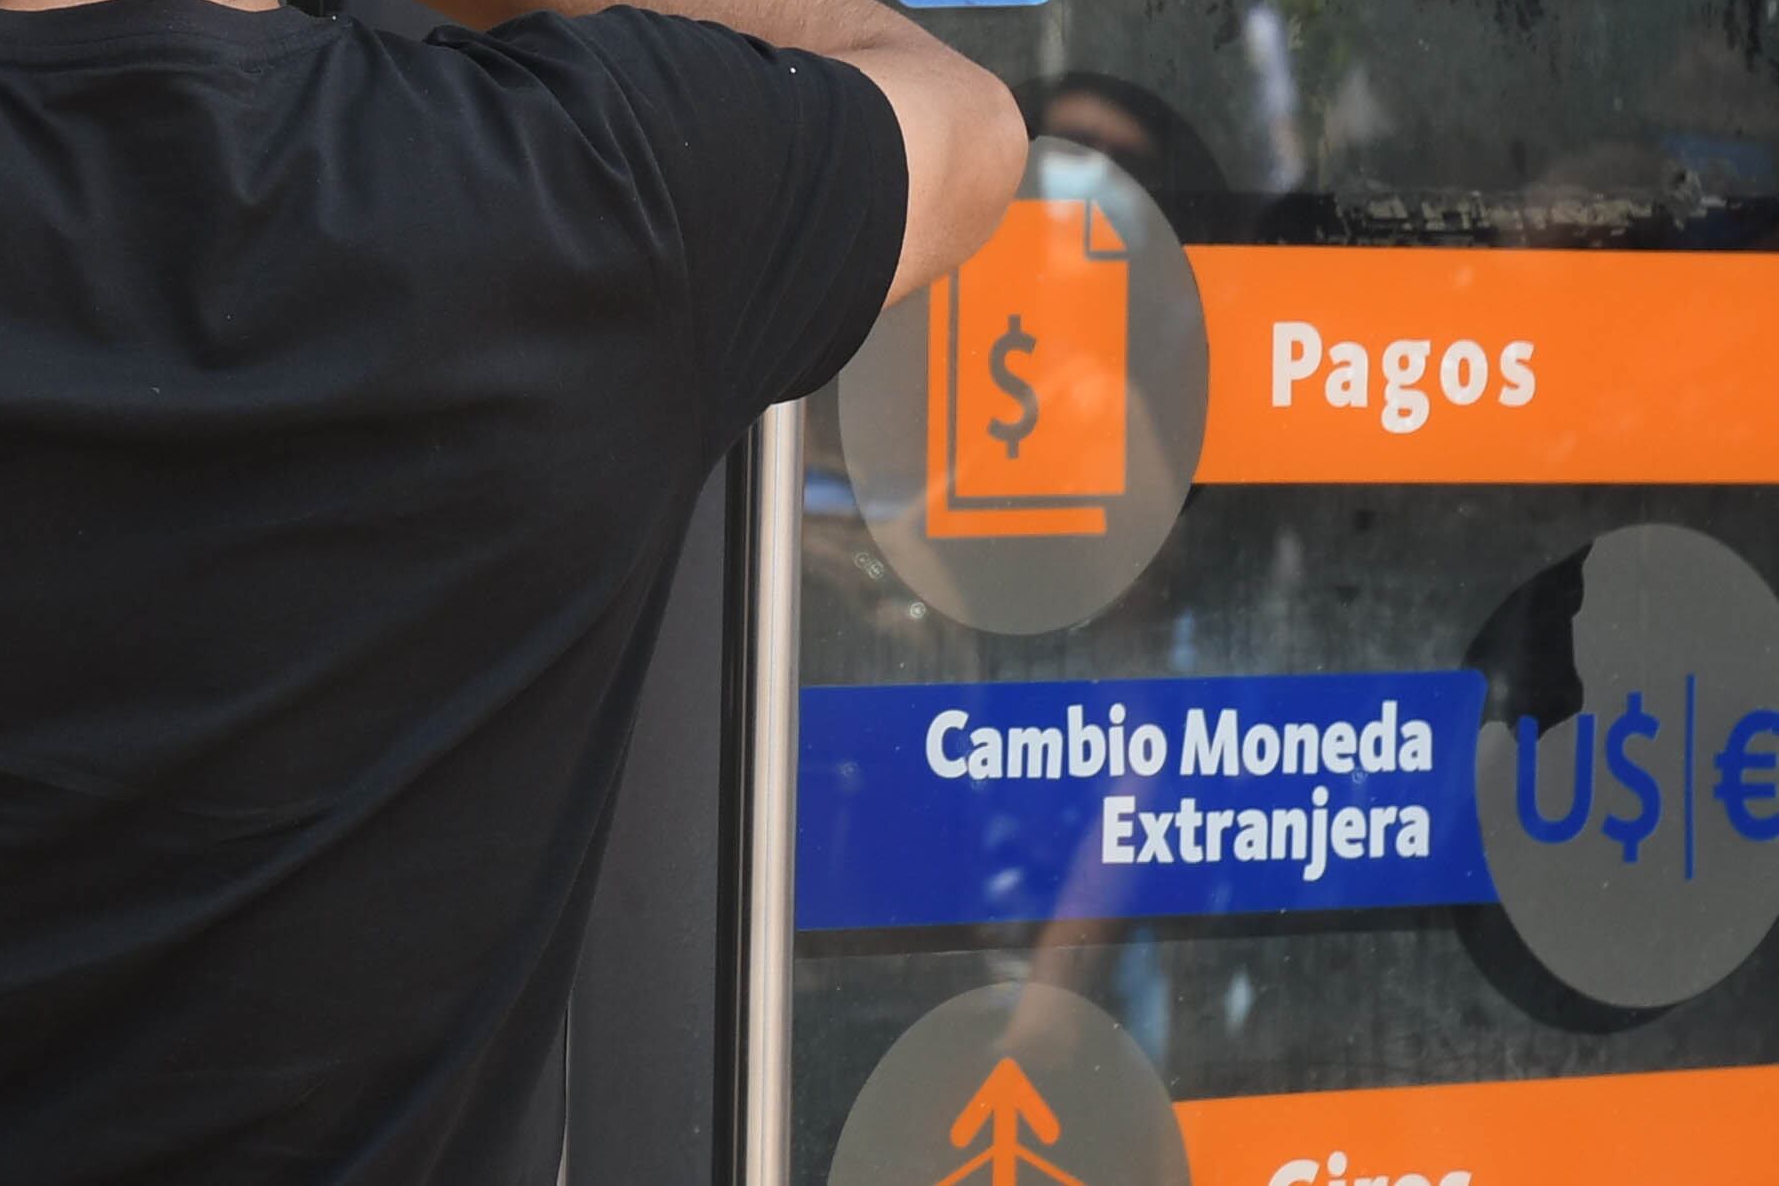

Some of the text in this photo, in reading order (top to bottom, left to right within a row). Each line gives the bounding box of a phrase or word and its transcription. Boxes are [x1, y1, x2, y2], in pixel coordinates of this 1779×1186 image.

[1270, 321, 1537, 434] Pagos
[924, 700, 1434, 781] Cambio Moneda
[1101, 786, 1431, 882] Extranjera
